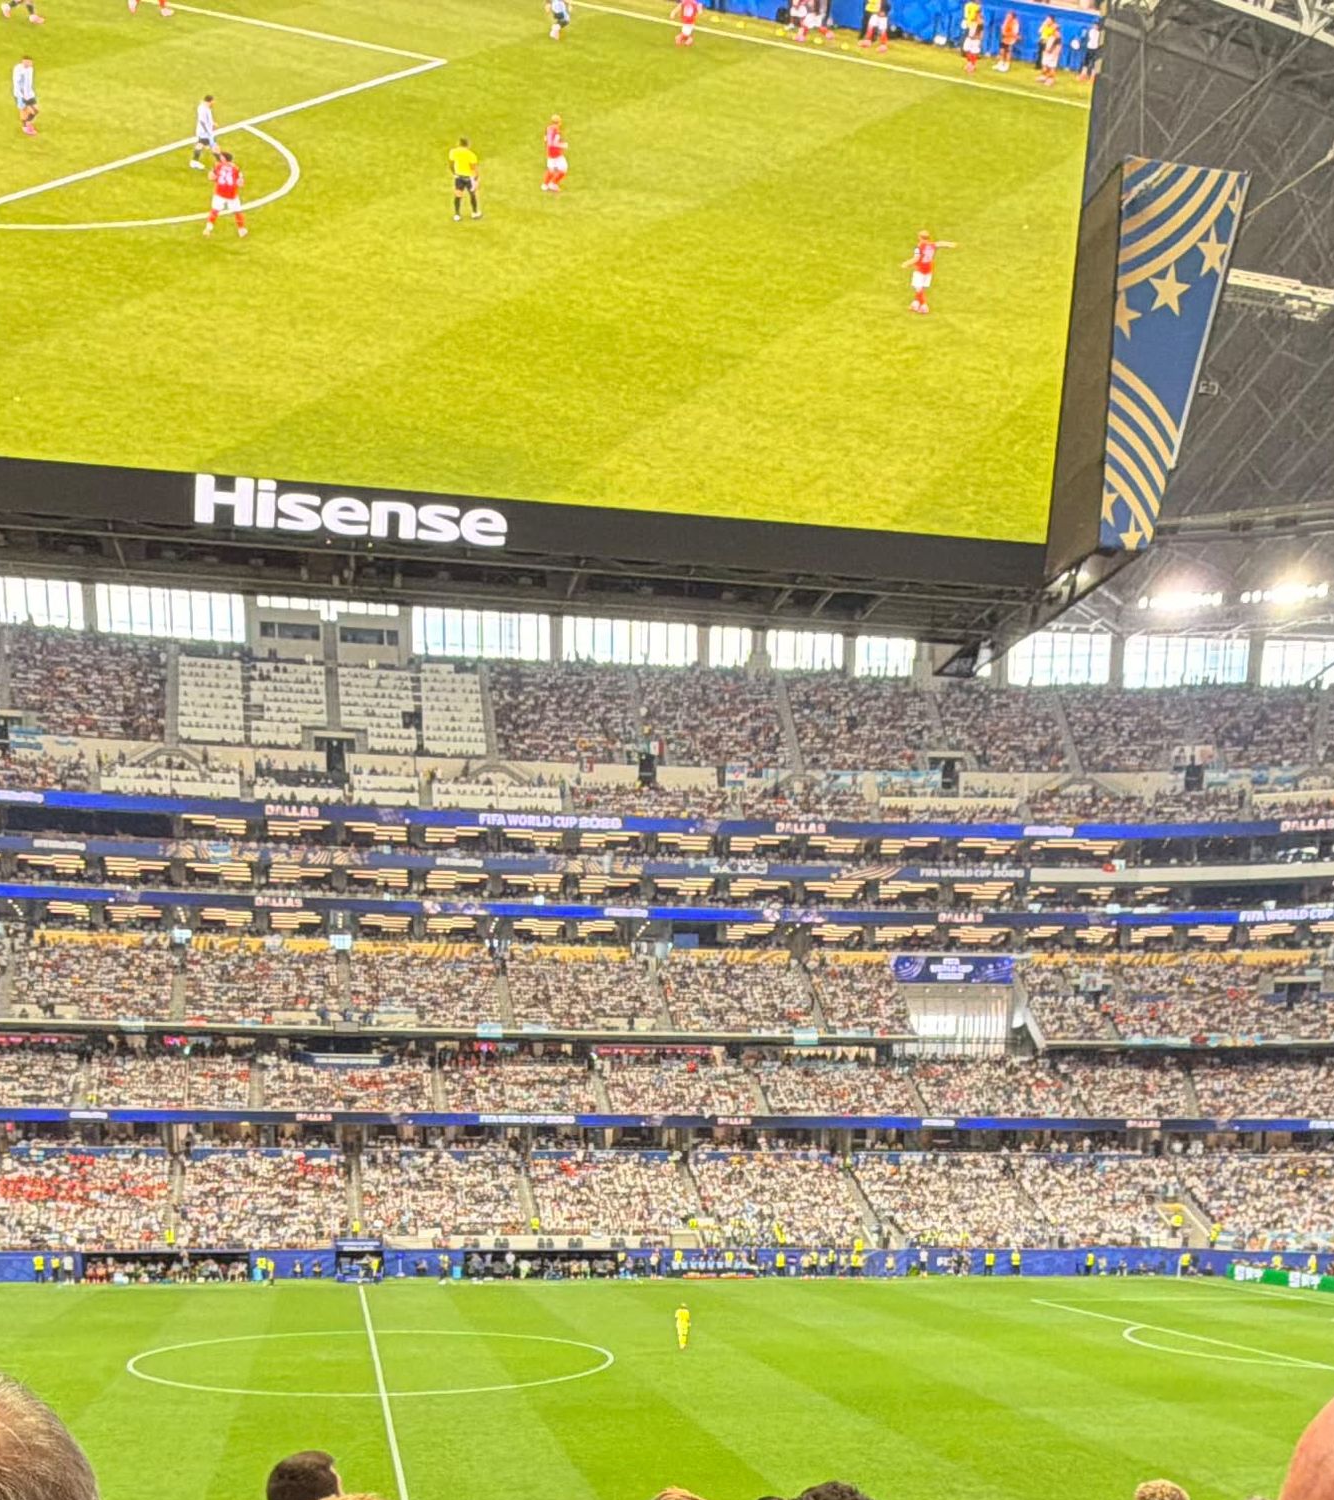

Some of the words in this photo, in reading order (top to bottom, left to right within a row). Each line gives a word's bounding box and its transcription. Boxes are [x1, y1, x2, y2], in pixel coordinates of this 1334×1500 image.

[194, 473, 508, 547] Hisense
[265, 805, 319, 818] DALLAS
[479, 813, 506, 826] FIFA
[507, 814, 551, 827] WORLD
[553, 816, 578, 829] CUP
[775, 822, 826, 834] DALLAS
[255, 897, 303, 907] DALLAS
[938, 913, 983, 923] DALLAS
